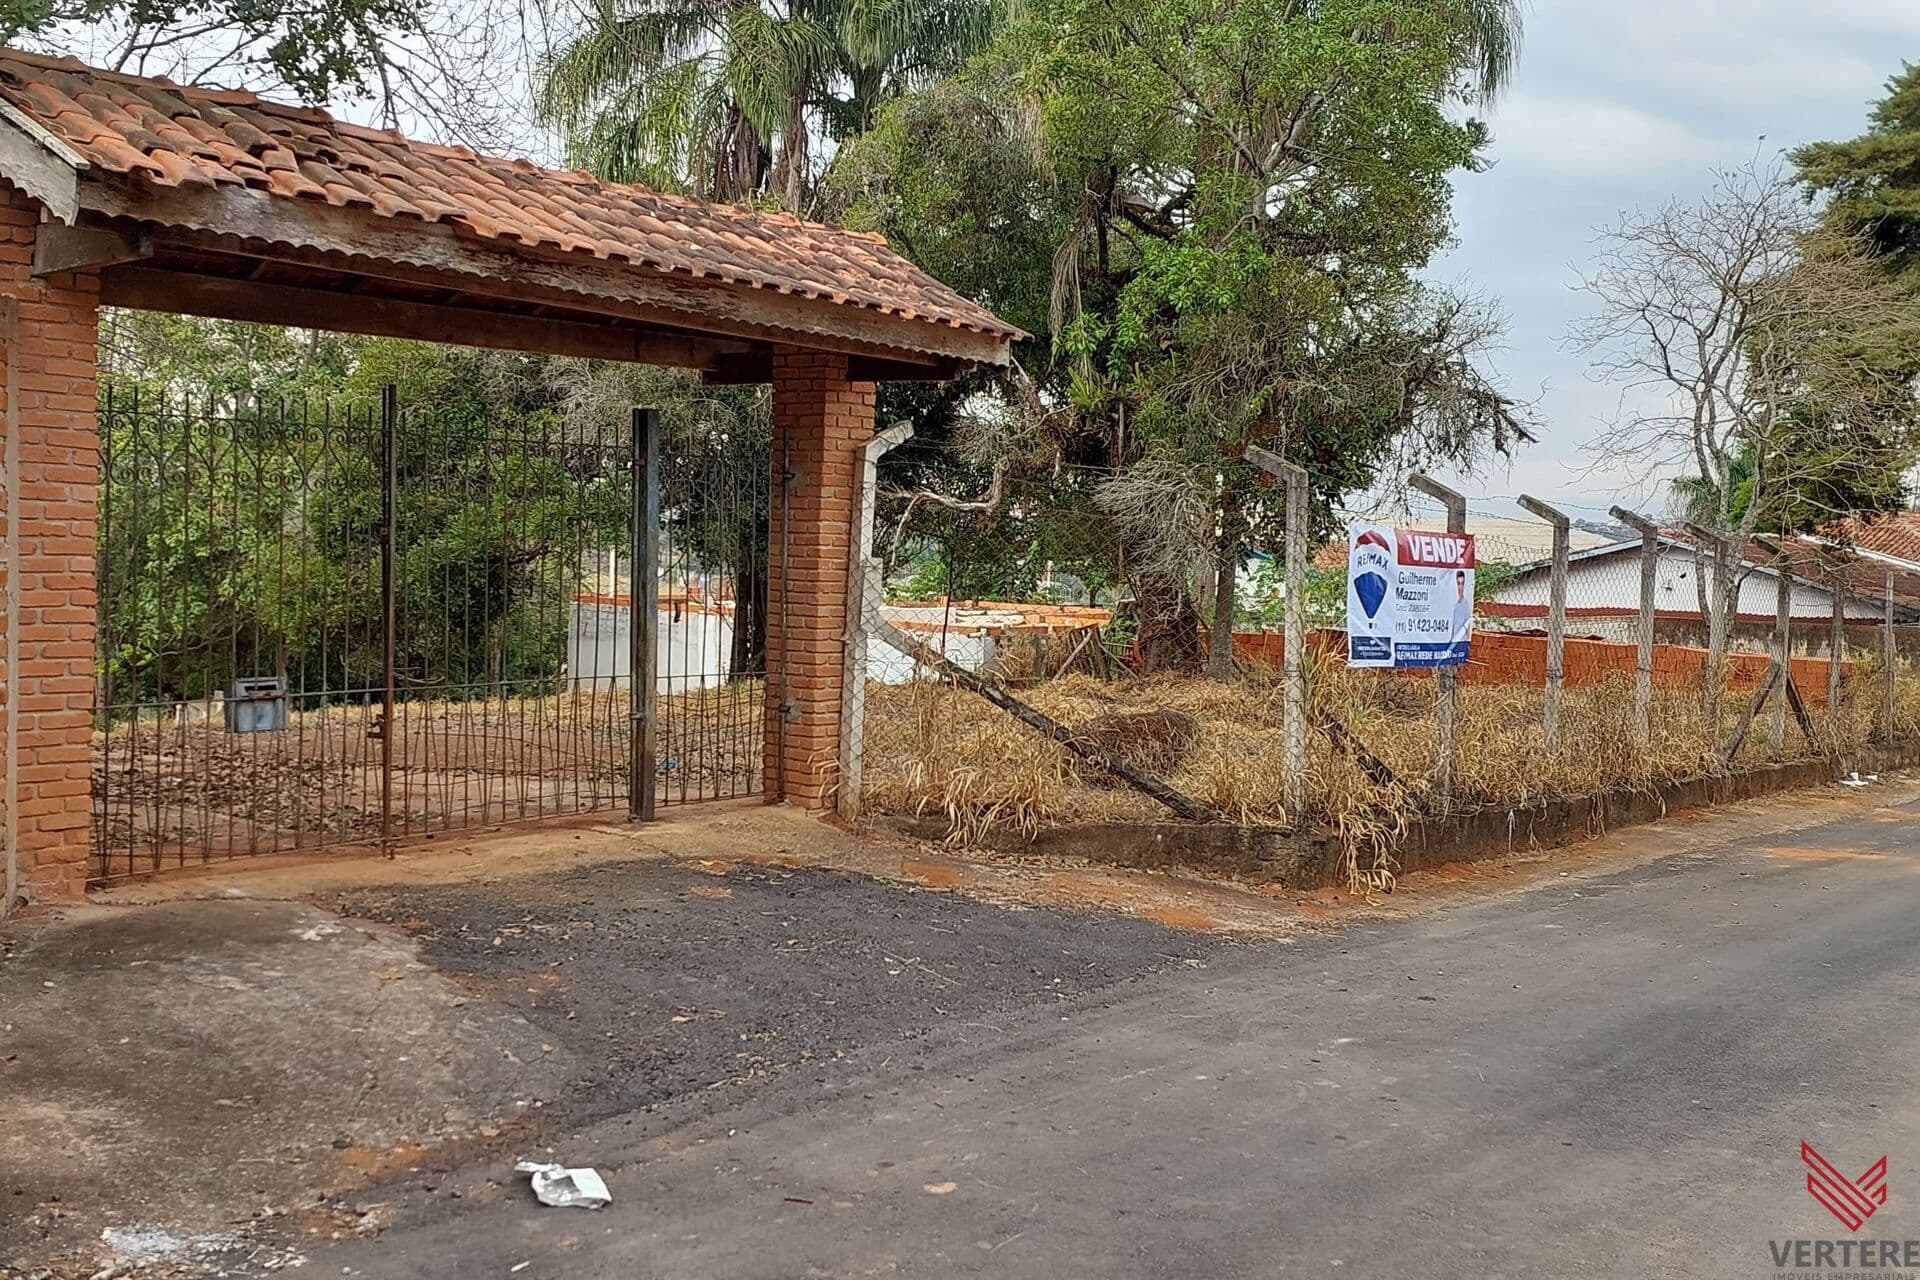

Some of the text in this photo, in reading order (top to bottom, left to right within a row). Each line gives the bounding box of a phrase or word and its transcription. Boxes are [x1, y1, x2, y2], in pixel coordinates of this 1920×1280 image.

[1406, 534, 1466, 564] VENDE
[1357, 553, 1389, 570] RE/MAX
[1398, 571, 1437, 586] Guilherme
[1395, 586, 1429, 601] Mazzoni
[1395, 618, 1449, 635] (11) 91423-0484
